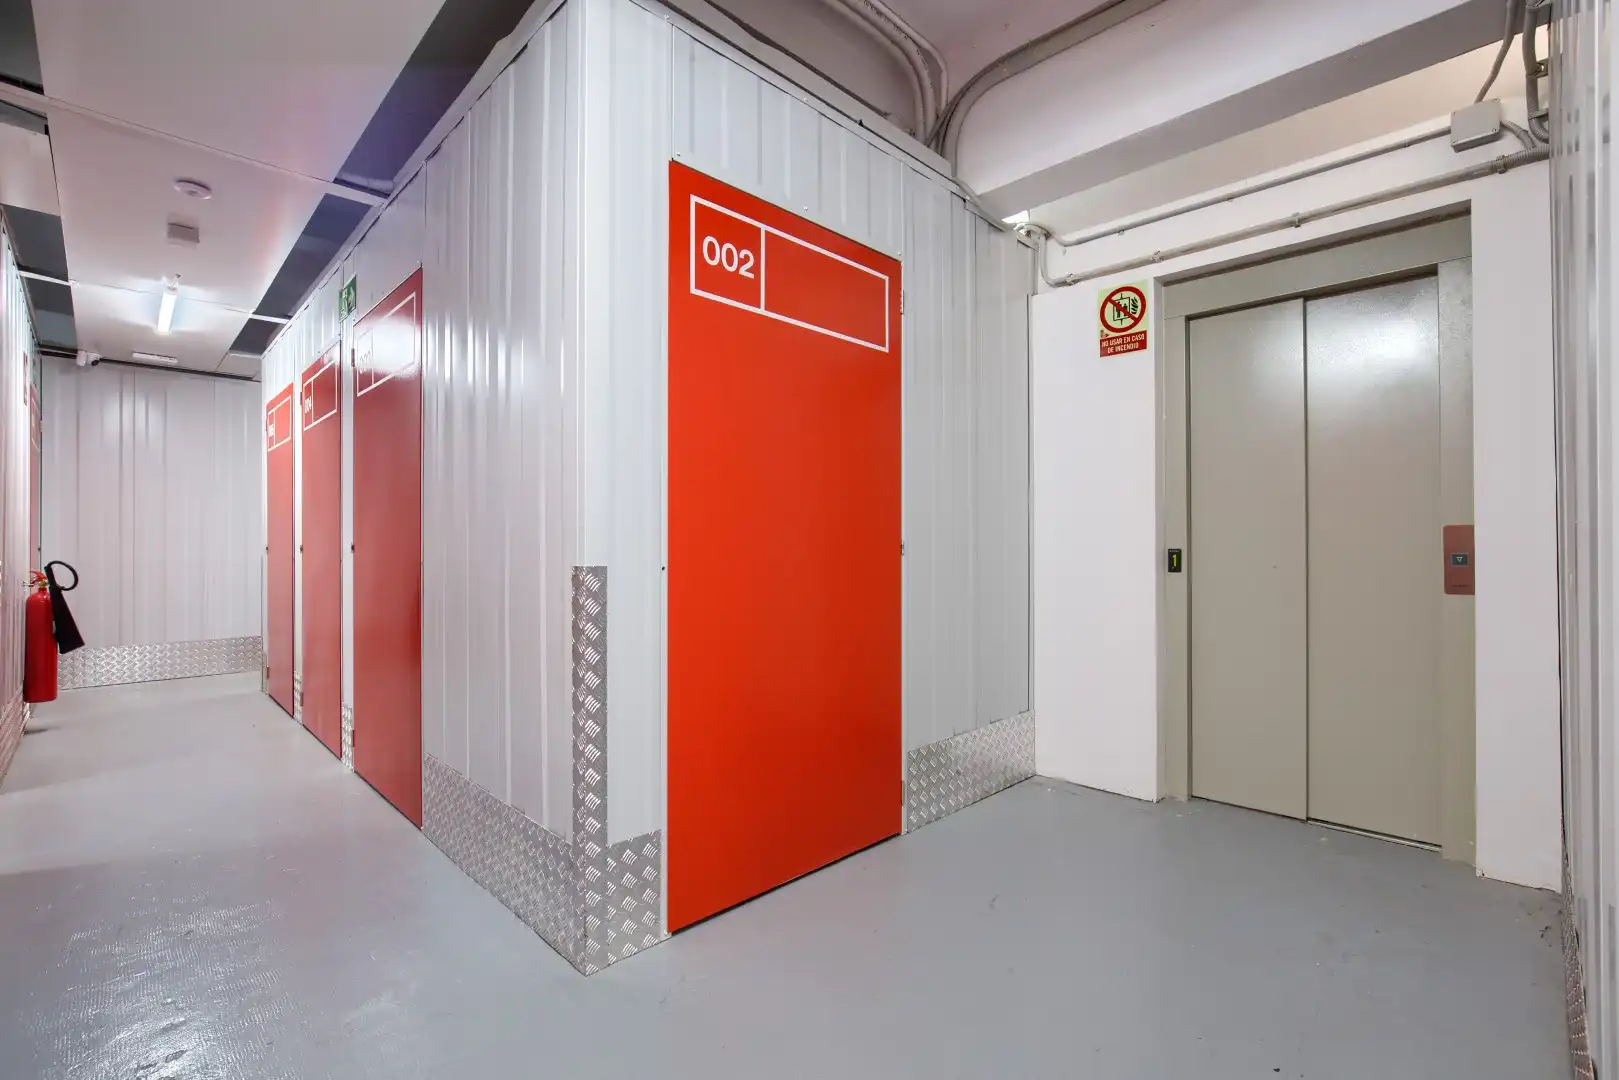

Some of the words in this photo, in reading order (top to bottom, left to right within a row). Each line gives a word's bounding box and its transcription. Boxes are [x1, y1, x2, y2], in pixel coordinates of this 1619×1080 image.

[702, 235, 755, 280] 002
[1109, 337, 1123, 346] USAR
[1123, 336, 1131, 344] EN
[1131, 333, 1145, 342] CASO
[1107, 346, 1115, 354] DE
[1115, 342, 1139, 352] INCENDIO
[1172, 554, 1177, 567] 1
